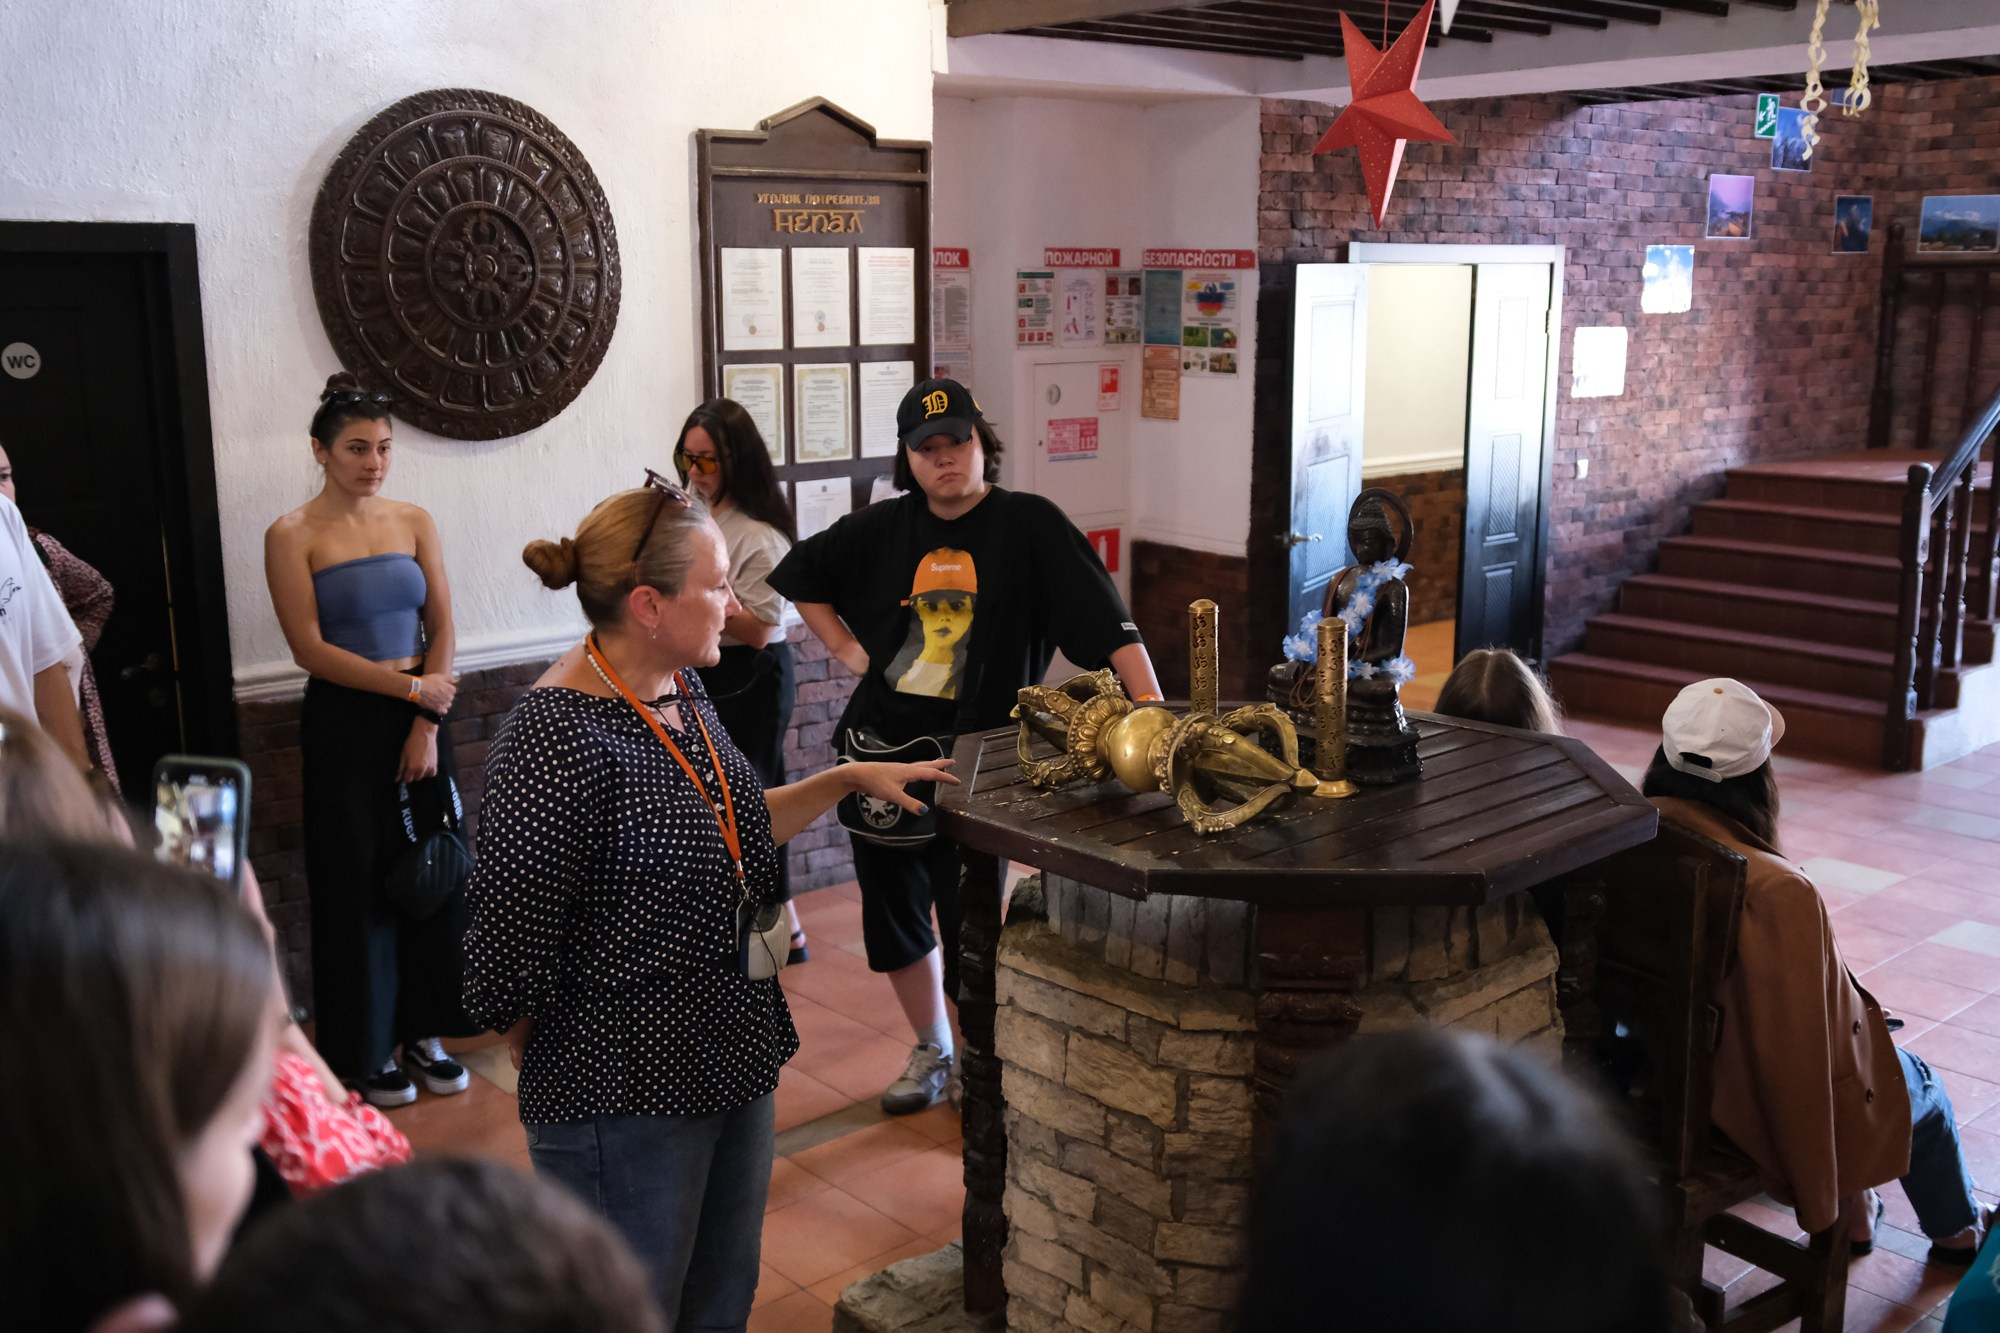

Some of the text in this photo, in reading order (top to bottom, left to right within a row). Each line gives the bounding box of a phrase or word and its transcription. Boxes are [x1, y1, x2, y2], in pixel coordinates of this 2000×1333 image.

[757, 193, 881, 205] УГОЛОК ПОТРЕБИТЕЛЯ
[933, 251, 961, 266] ЛОК
[1045, 249, 1113, 266] ПОЖАРНОЙ
[1143, 252, 1236, 267] БЕЗОПАСНОСТИ
[6, 354, 36, 369] WC
[1081, 436, 1097, 449] 112
[930, 562, 962, 573] Supreme
